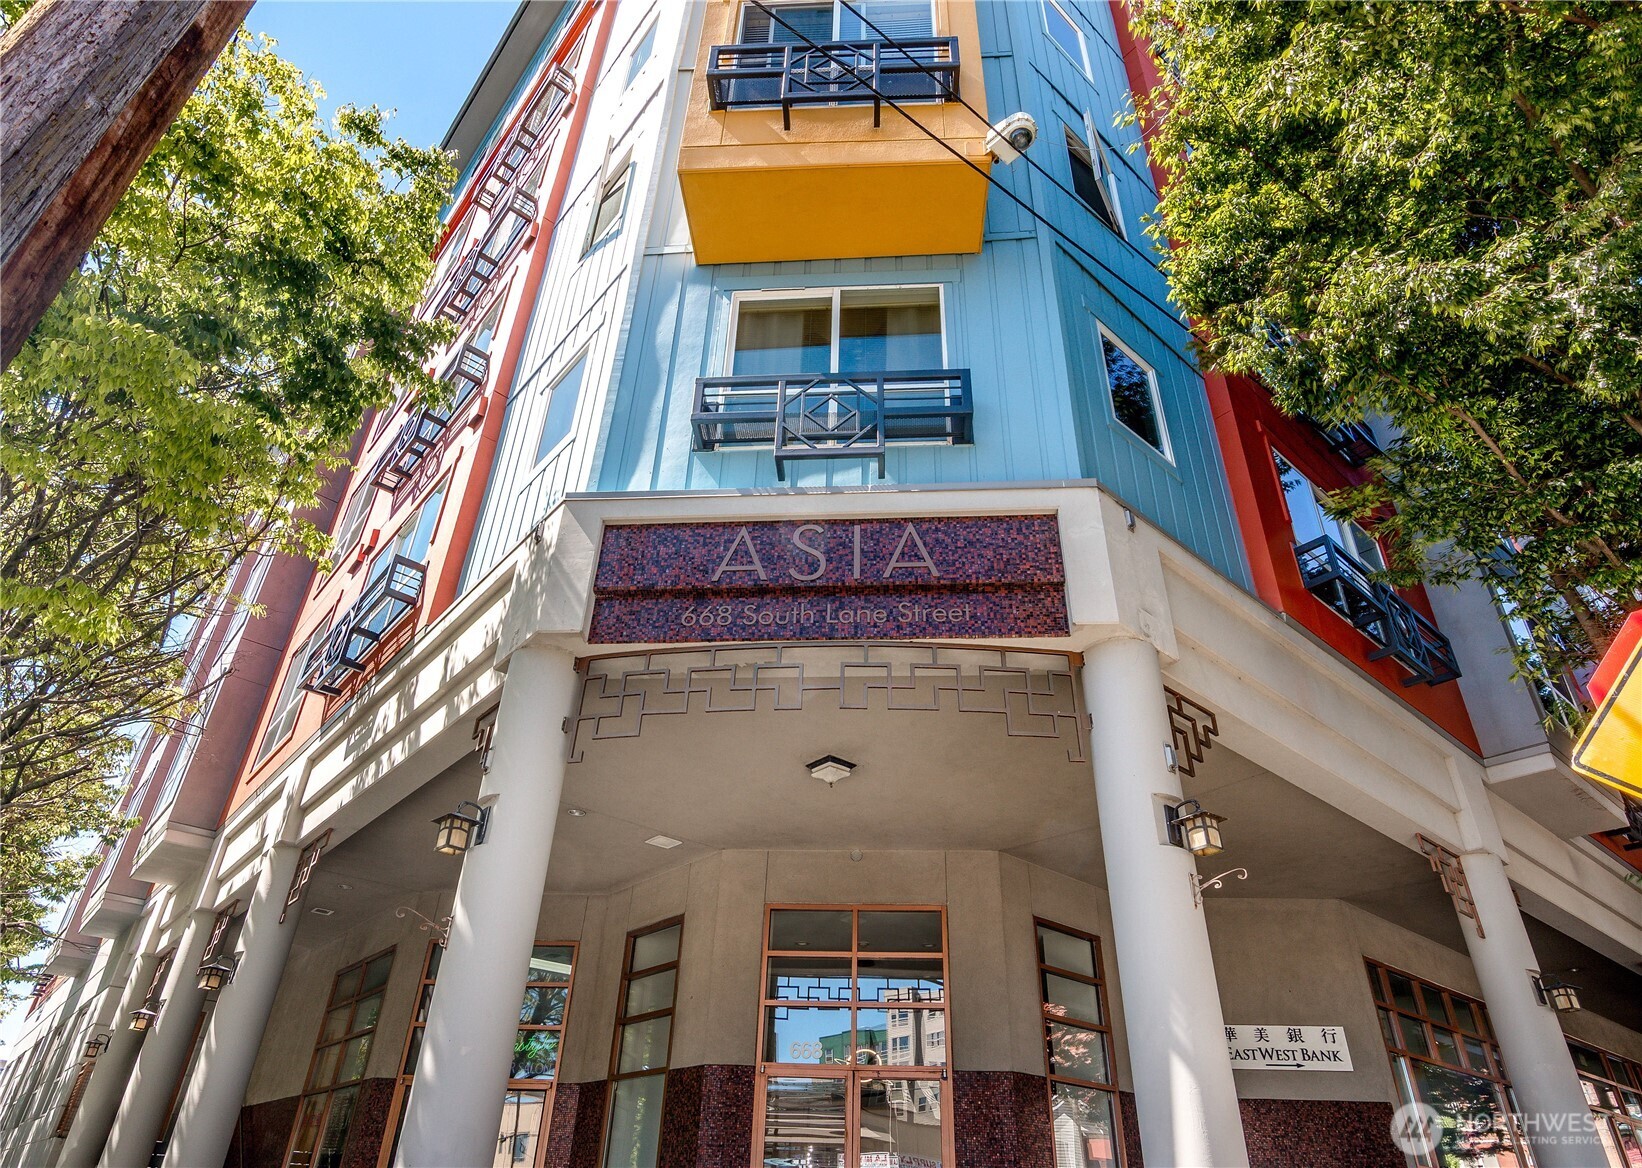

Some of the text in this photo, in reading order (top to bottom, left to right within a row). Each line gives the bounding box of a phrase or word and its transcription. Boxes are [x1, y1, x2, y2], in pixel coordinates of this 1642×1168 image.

[711, 521, 940, 582] ASIA
[680, 601, 972, 628] 668 South Lane Street
[789, 1040, 823, 1060] 668
[1301, 1048, 1344, 1063] BANK
